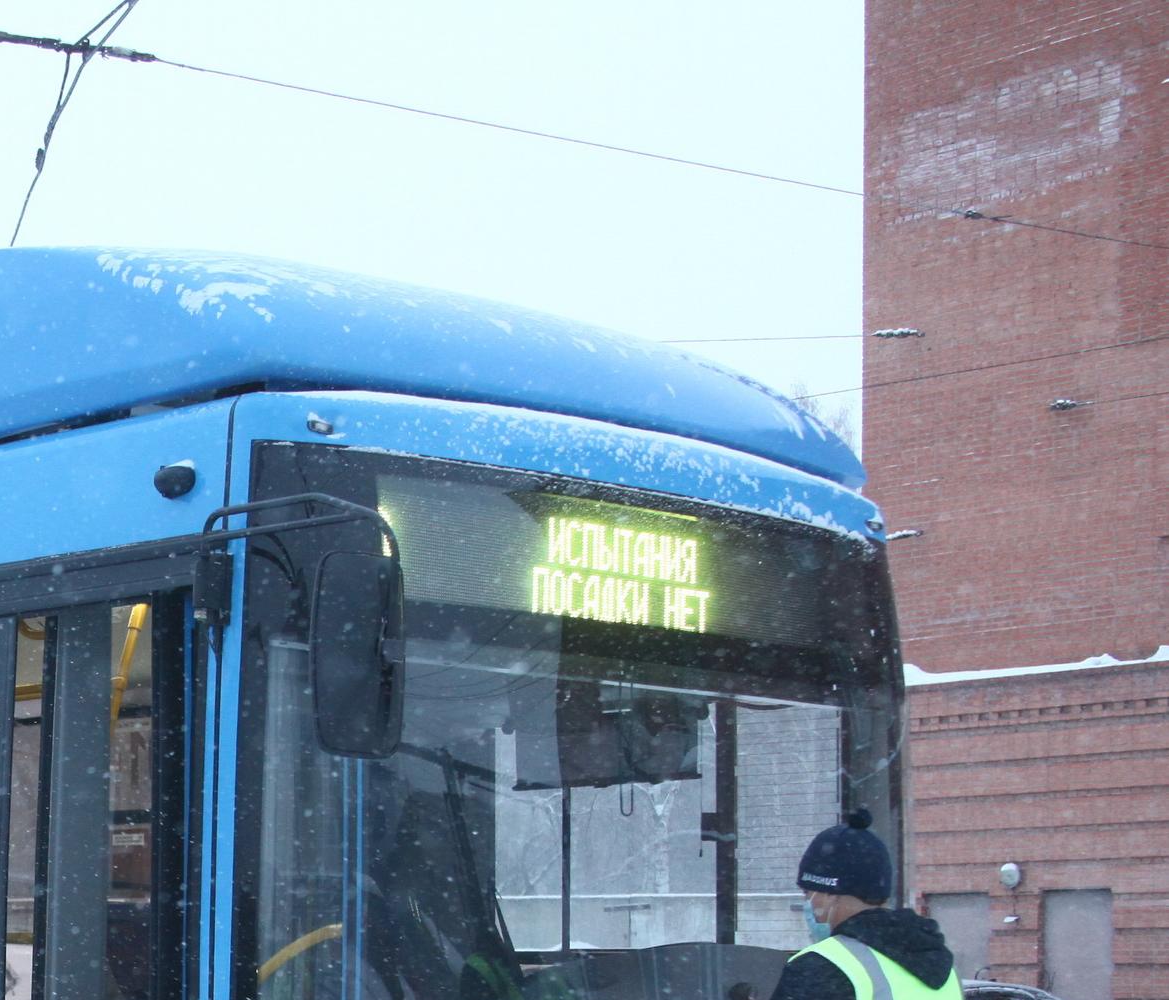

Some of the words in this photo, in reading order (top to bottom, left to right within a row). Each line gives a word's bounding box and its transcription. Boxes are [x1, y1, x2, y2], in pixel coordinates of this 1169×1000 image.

[547, 516, 698, 584] ИСПЫТАНИЯ
[531, 566, 650, 626] ПОСАДКИ
[662, 585, 711, 634] НЕТ
